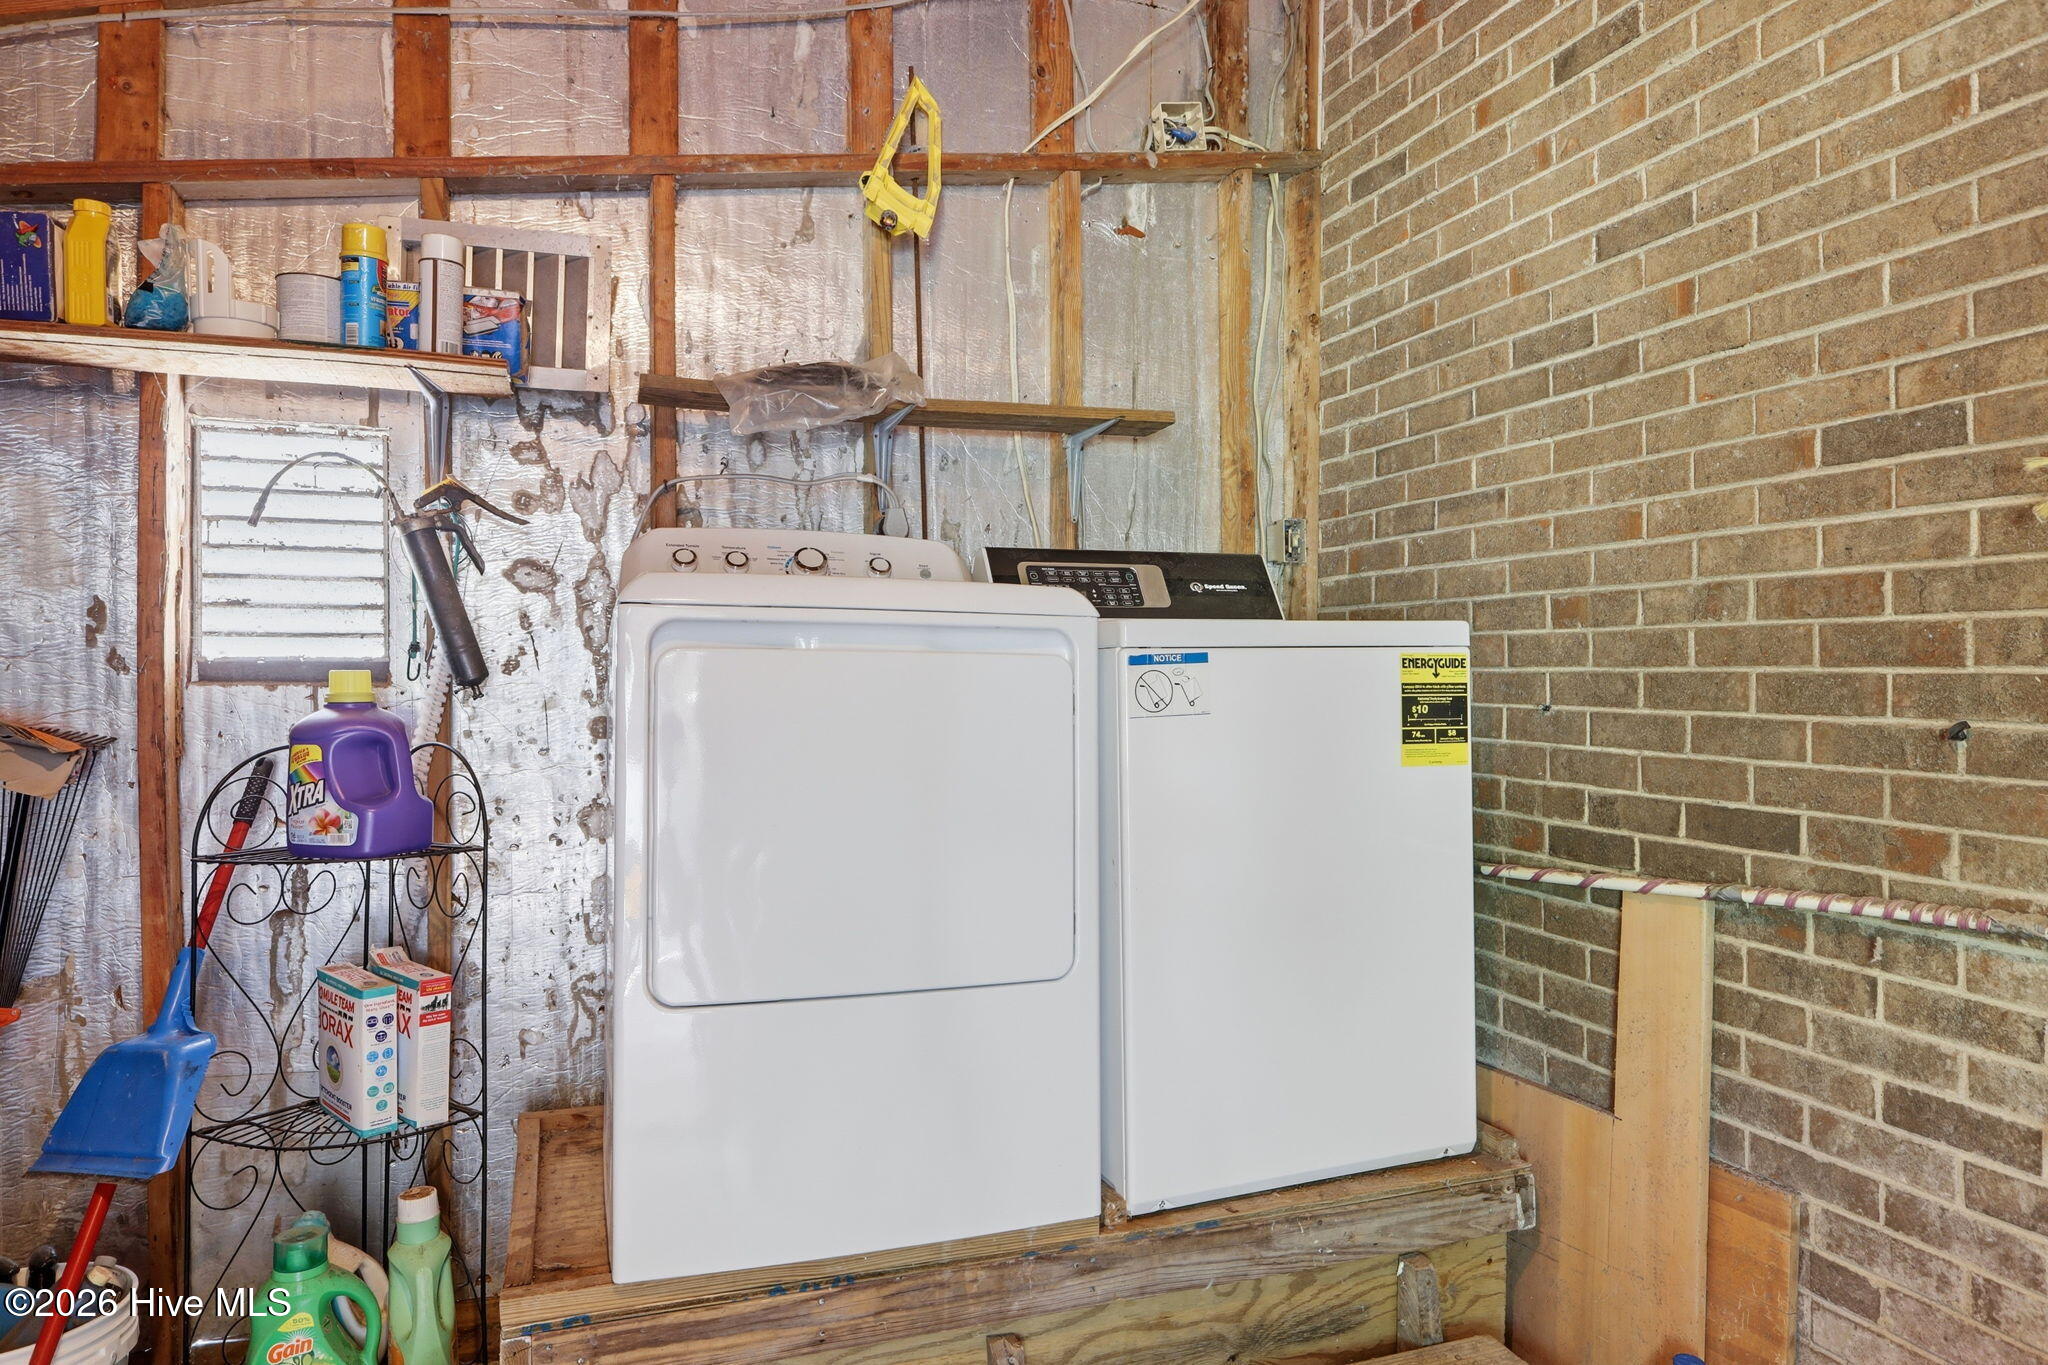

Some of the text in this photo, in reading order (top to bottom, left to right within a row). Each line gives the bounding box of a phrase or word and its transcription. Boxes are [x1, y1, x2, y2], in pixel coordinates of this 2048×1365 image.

[1153, 654, 1182, 662] NOTICE
[1401, 657, 1467, 669] ENERGYGUIDE
[1411, 704, 1429, 714] $10
[1411, 730, 1421, 738] 74
[288, 778, 326, 816] XTRA
[323, 987, 338, 1006] MULE
[338, 995, 355, 1013] TEAM
[267, 1337, 313, 1364] Gain
